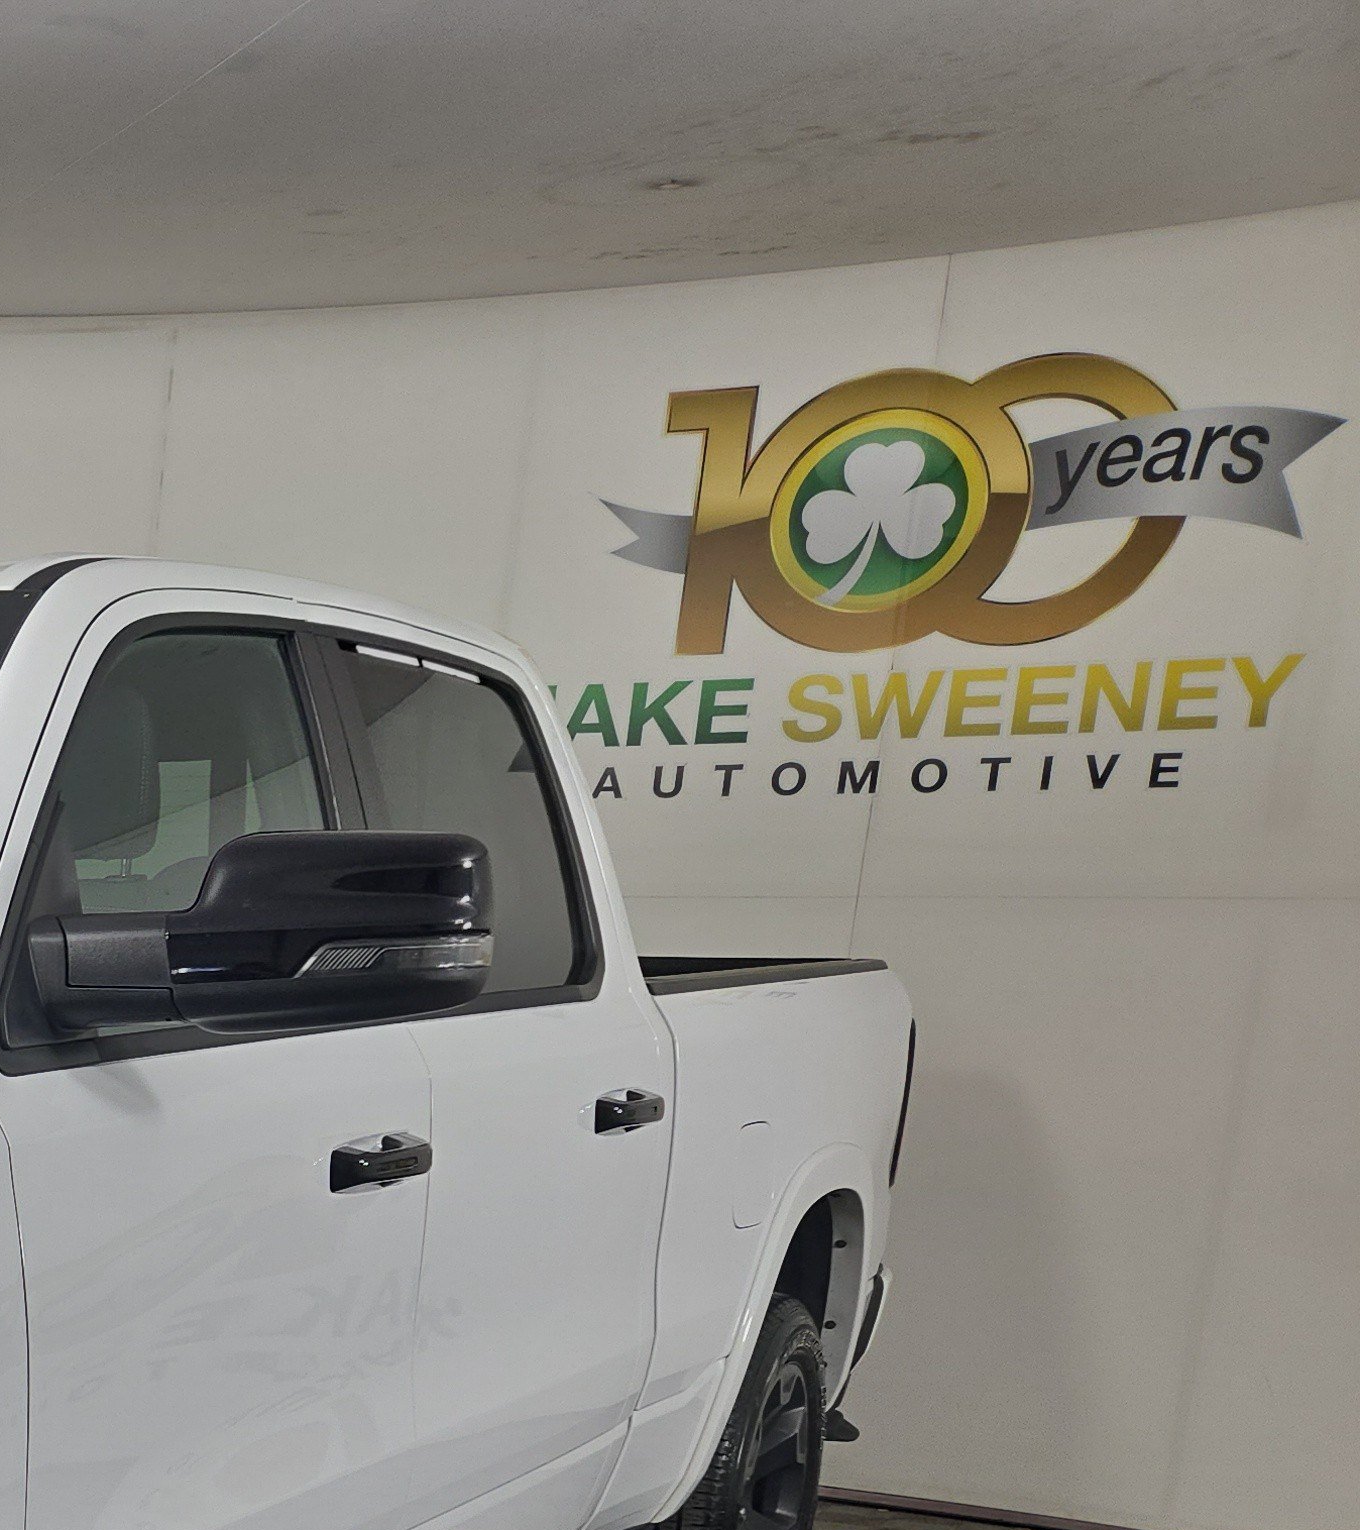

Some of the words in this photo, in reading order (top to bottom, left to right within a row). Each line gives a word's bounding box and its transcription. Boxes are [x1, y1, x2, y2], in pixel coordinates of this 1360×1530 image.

[666, 352, 1187, 656] 100
[1045, 422, 1270, 514] years
[547, 677, 755, 748] AKE
[781, 652, 1307, 747] SWEENEY
[591, 751, 1184, 800] AUTOMOTIVE
